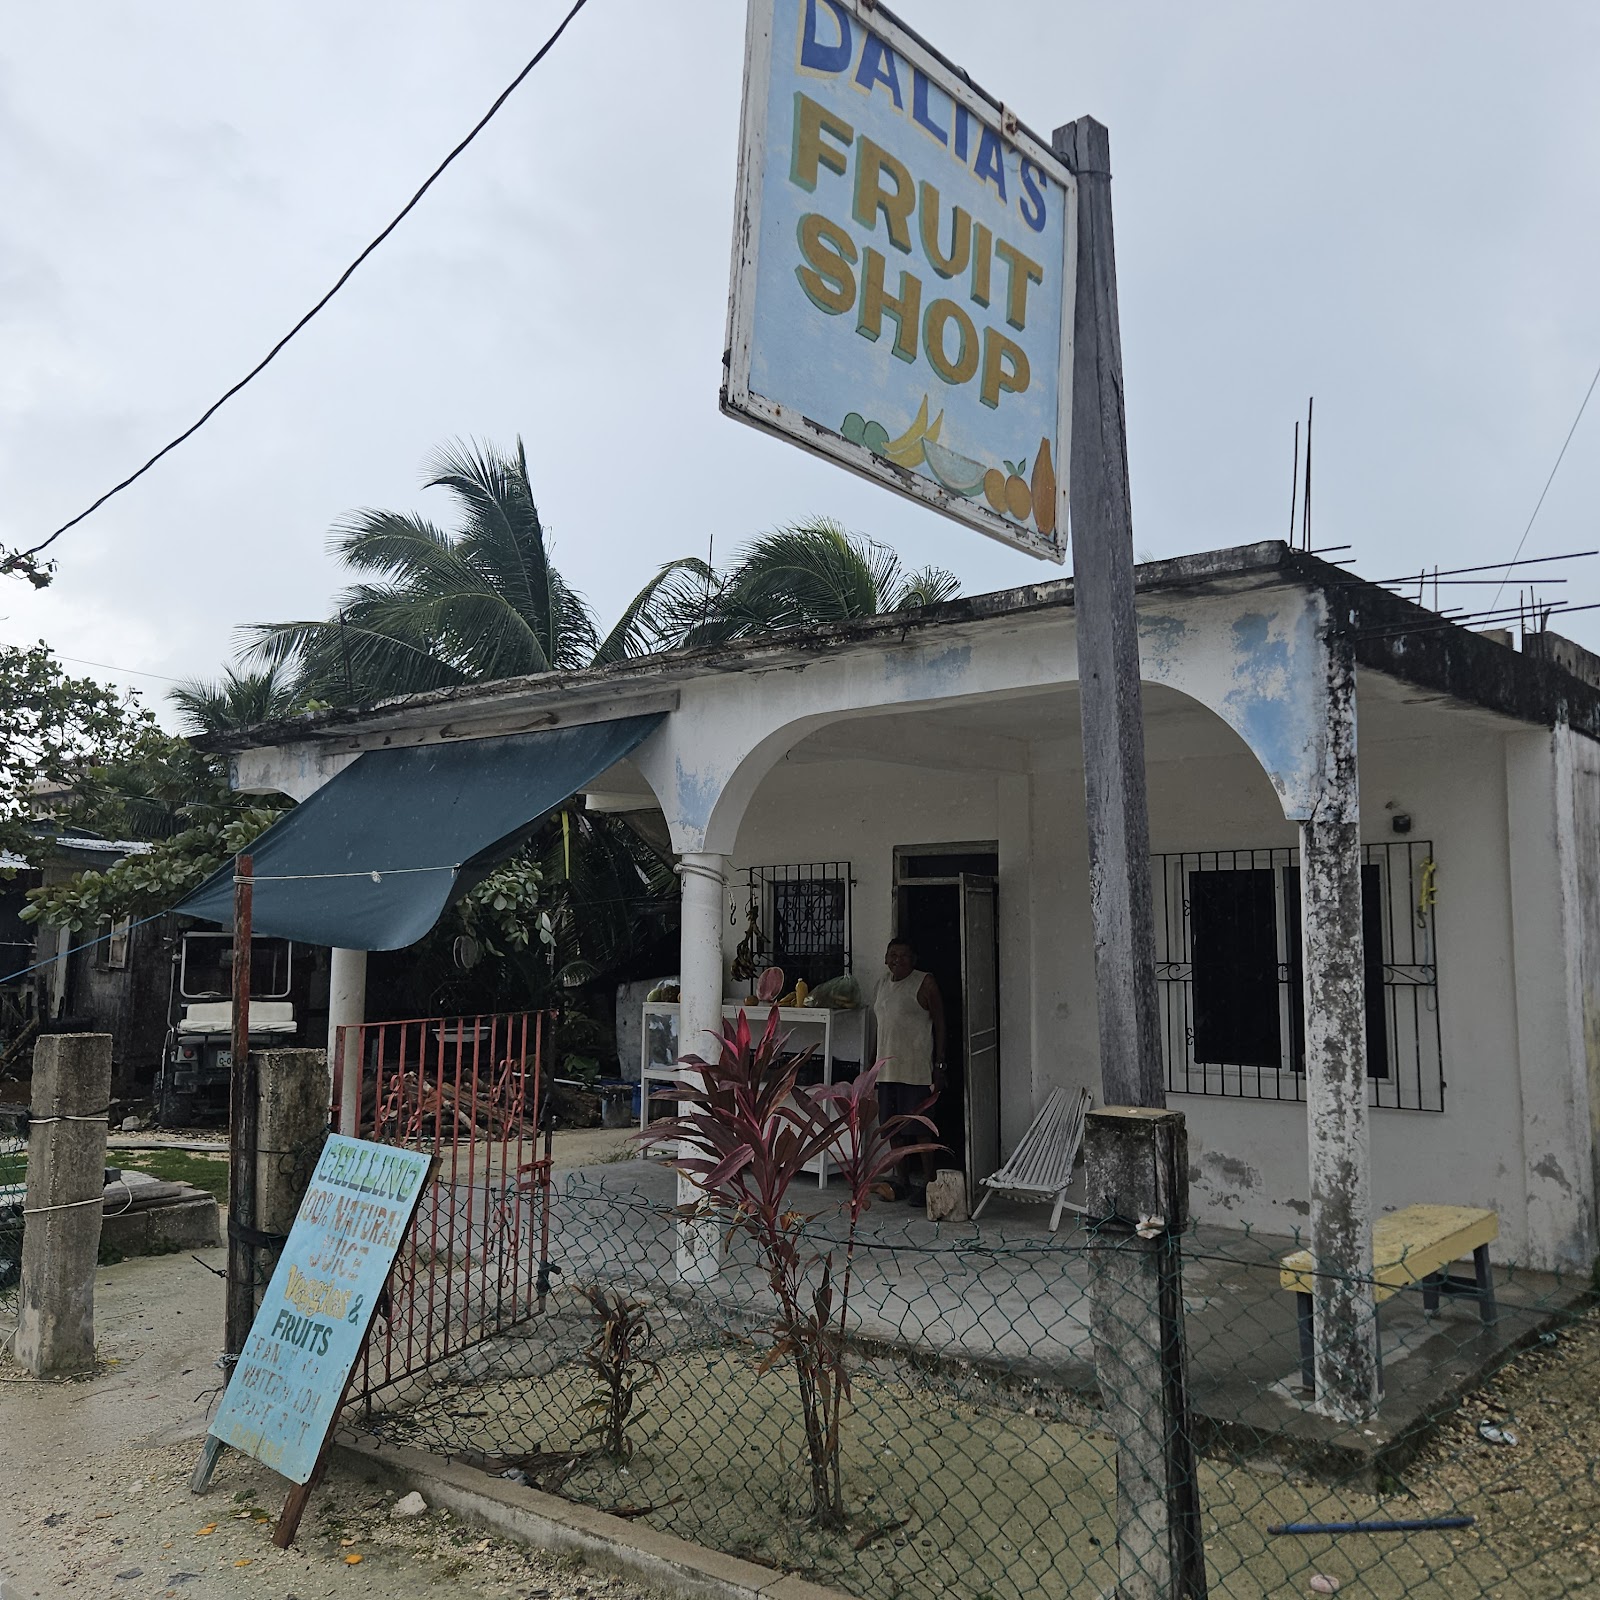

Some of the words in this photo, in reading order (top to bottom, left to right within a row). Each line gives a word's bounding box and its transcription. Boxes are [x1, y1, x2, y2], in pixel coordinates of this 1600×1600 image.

[789, 90, 1043, 331] FRUIT
[794, 212, 1031, 410] SHOP
[299, 1187, 336, 1227] 100%
[329, 1196, 404, 1249] NATURAL
[309, 1234, 370, 1281] JUICE
[284, 1264, 354, 1319] Veggies
[348, 1294, 364, 1325] &
[271, 1309, 333, 1356] FRUITS
